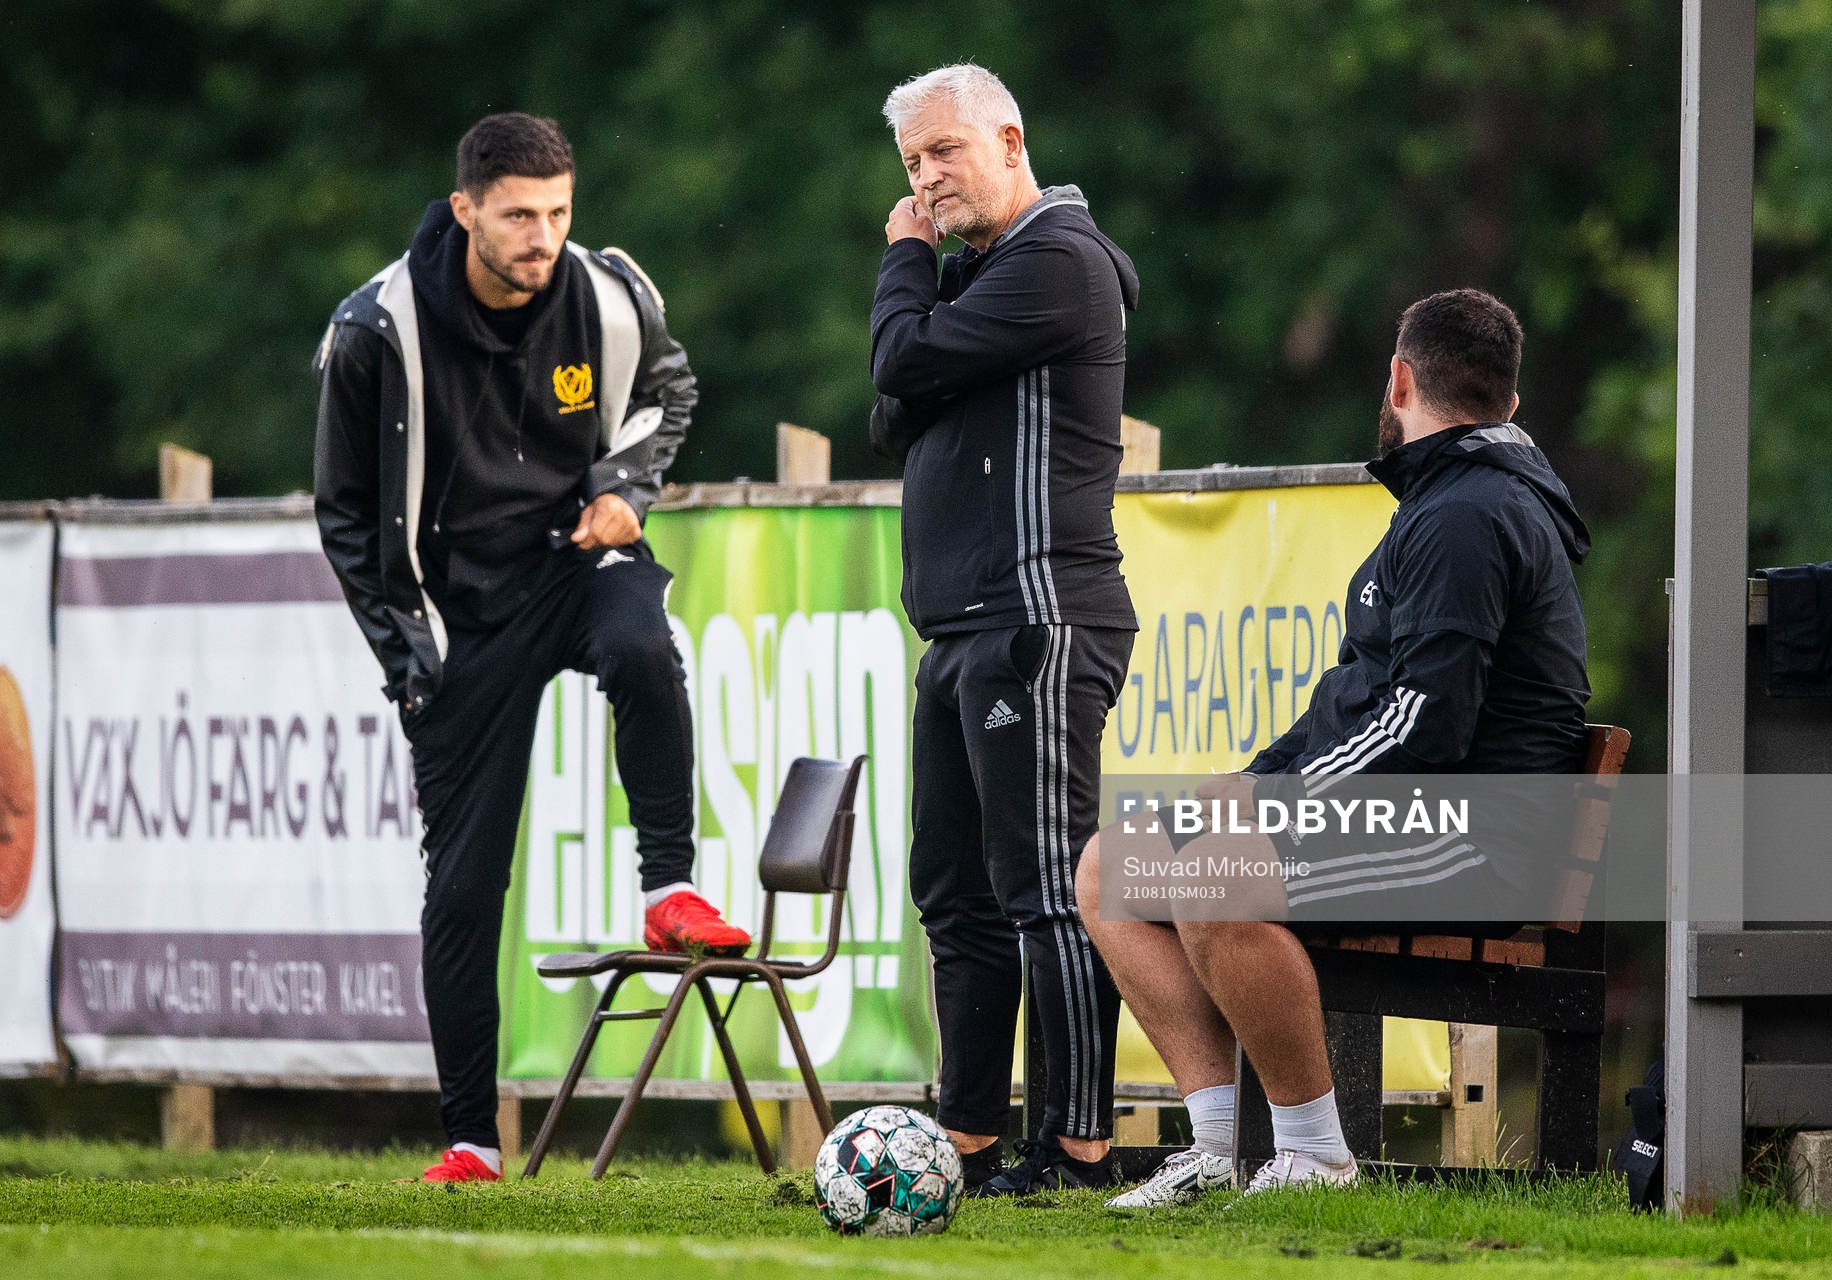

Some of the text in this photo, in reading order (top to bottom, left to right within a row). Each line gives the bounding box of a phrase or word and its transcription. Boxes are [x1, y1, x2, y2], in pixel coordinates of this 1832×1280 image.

[984, 713, 1021, 730] adidas
[322, 714, 348, 839] &
[231, 949, 328, 1015] FÖNSTER
